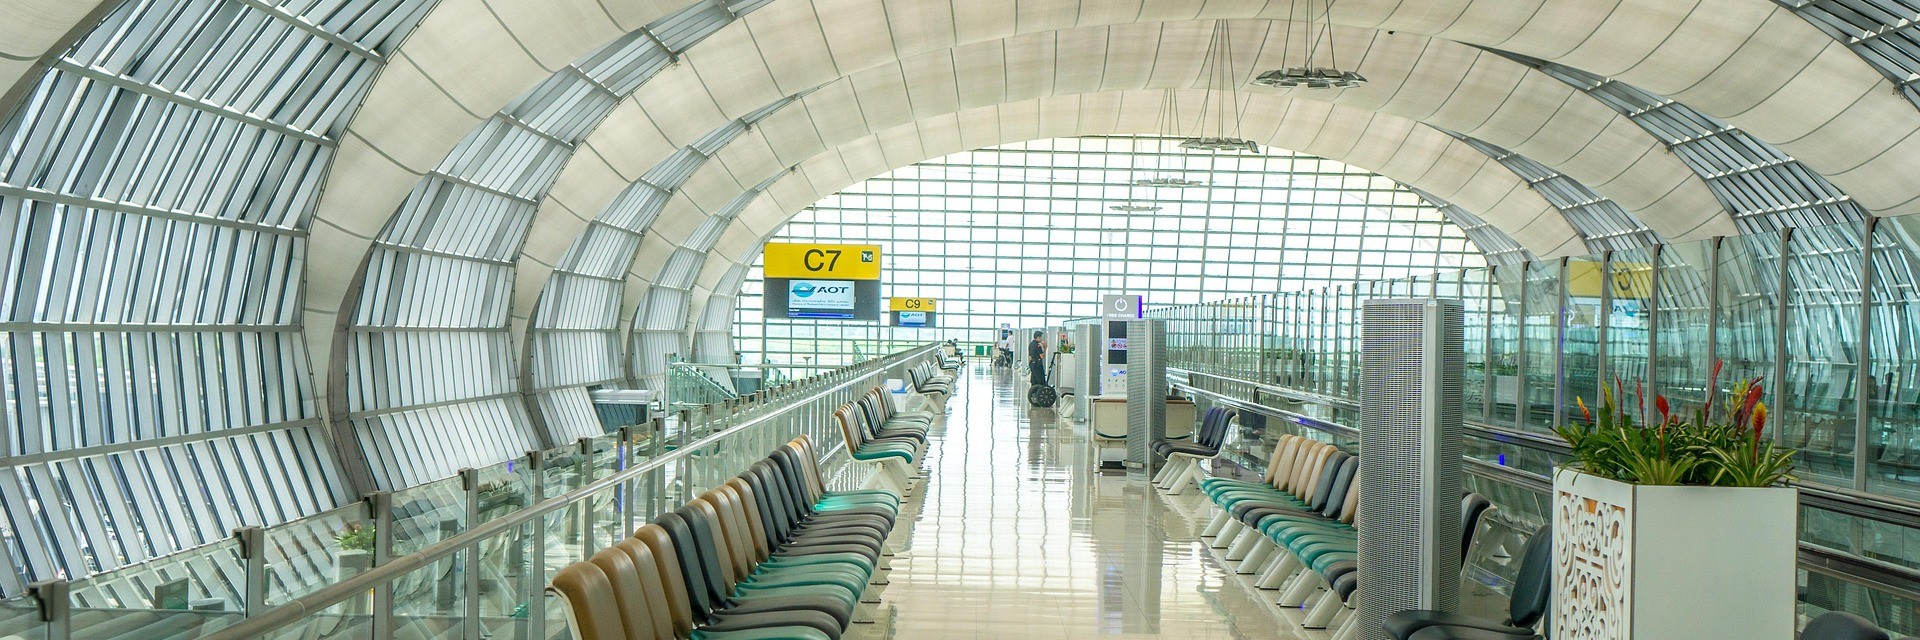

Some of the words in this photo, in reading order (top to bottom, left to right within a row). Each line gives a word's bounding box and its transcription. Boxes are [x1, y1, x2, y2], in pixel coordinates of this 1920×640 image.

[804, 249, 841, 272] C7
[817, 286, 849, 294] AOT
[905, 299, 921, 309] C9
